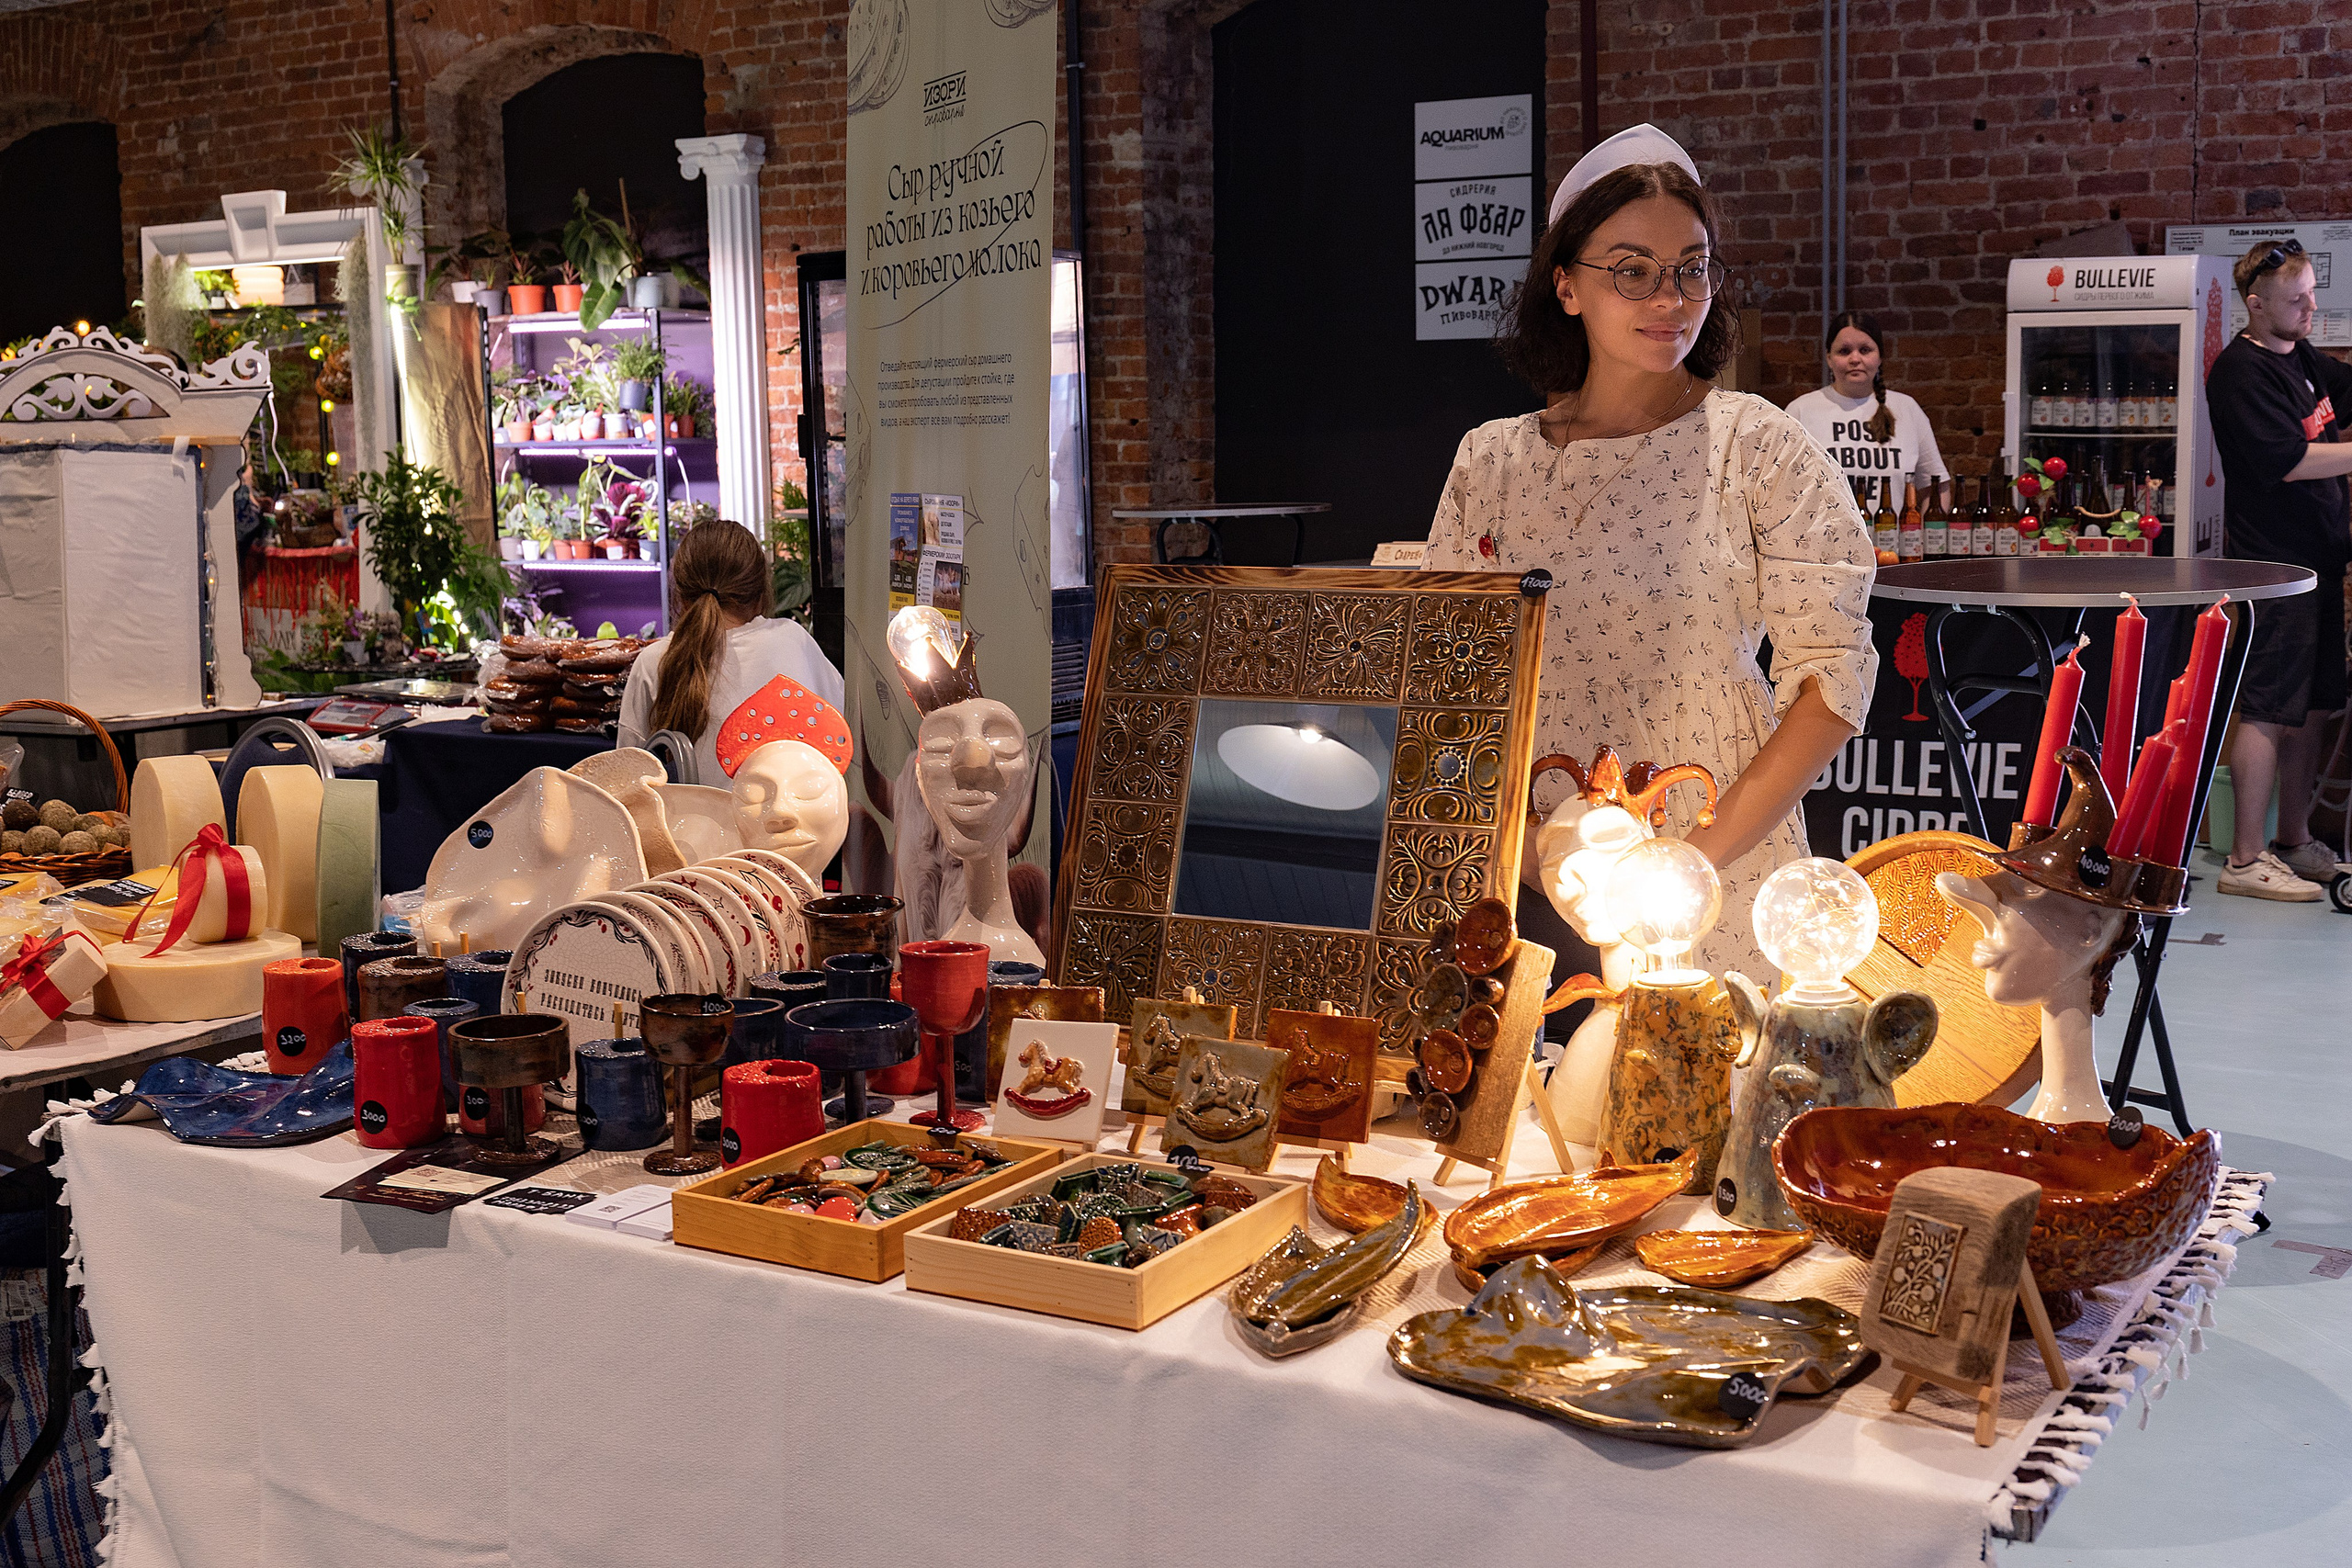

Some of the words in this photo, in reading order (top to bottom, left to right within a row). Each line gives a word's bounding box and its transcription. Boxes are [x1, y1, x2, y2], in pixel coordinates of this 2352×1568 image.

[923, 76, 967, 107] ИЗОРИ
[1419, 126, 1505, 147] AQUARIUM
[888, 164, 923, 205] Сыр
[930, 139, 1004, 201] ручной
[1450, 184, 1497, 197] СИДРЕРИЯ
[866, 210, 925, 260] работы
[931, 208, 952, 238] из
[958, 189, 1035, 232] козьего
[2251, 228, 2295, 237] эвакуации
[861, 269, 870, 296] и
[872, 253, 965, 300] коровьего
[967, 239, 1042, 278] молока
[2075, 267, 2156, 288] BULLEVIE
[1419, 276, 1523, 312] DWAR
[2074, 292, 2096, 301] СИДРЫ
[2096, 292, 2126, 300] ПЕРВОГО
[2127, 291, 2155, 300] ОТЖИМА
[933, 355, 967, 370] фермерский
[978, 353, 1012, 367] домашнего
[921, 377, 952, 390] дегустации
[1004, 373, 1014, 386] где
[941, 394, 959, 406] любой
[967, 394, 1012, 408] представленных
[942, 416, 952, 425] вам
[978, 412, 1010, 427] расскажет!
[1832, 419, 1877, 443] POS
[1826, 446, 1902, 469] ABOUT
[469, 828, 492, 839] 5000
[702, 1001, 726, 1013] 1000
[280, 1033, 306, 1045] 3200
[361, 1109, 386, 1122] 3000
[2109, 1116, 2142, 1133] 9000
[1727, 1376, 1767, 1404] 5000
